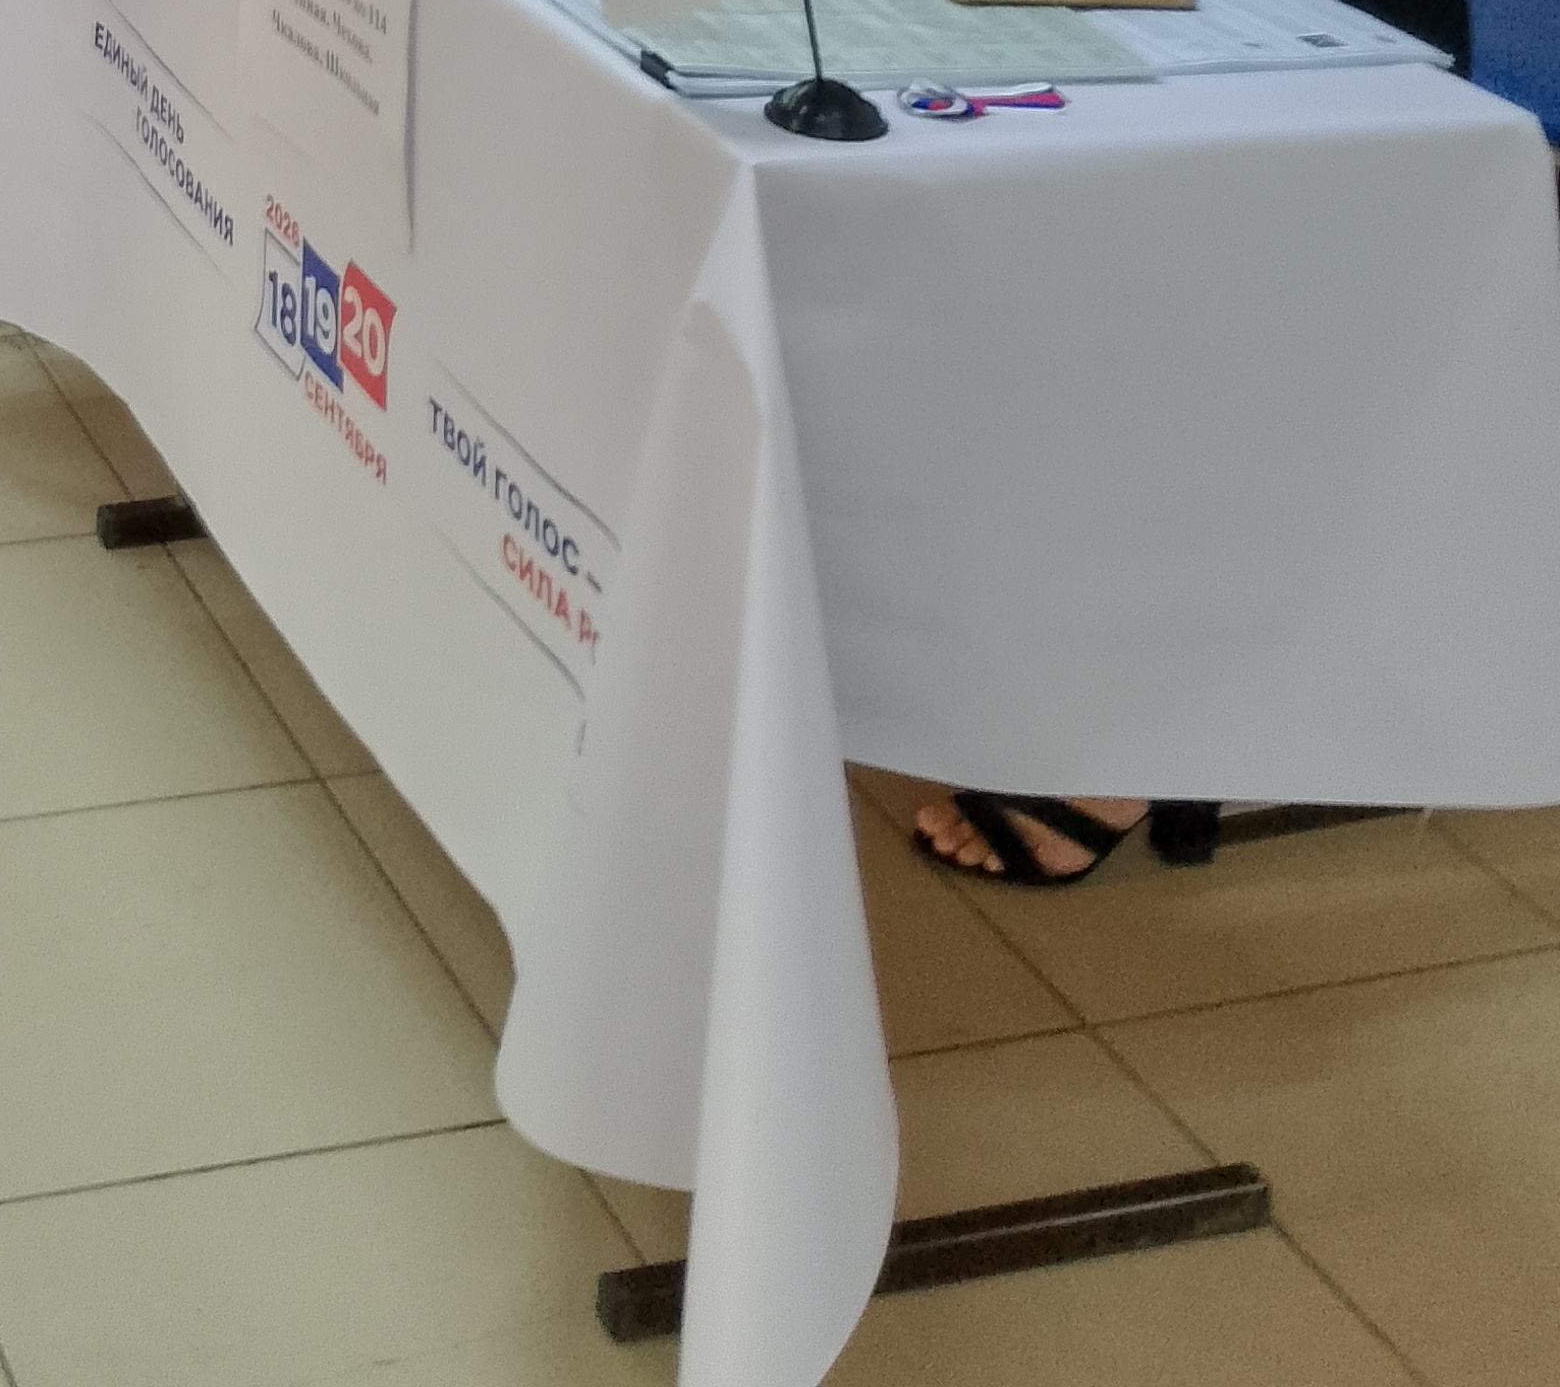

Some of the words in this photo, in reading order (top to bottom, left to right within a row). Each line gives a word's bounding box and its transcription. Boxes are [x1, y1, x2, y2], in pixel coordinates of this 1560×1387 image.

[94, 21, 148, 102] ЕДИНЫЙ
[150, 84, 185, 145] ДЕНЬ
[136, 105, 234, 247] ГОЛОСОВАНИЯ
[268, 271, 298, 346] 18
[304, 276, 337, 356] 19
[342, 286, 386, 376] 20
[304, 371, 387, 485] СЕНТЯБРЯ
[429, 397, 487, 488] ТВОЙ
[494, 466, 580, 577] ГОЛОС
[502, 532, 572, 629] СИЛА
